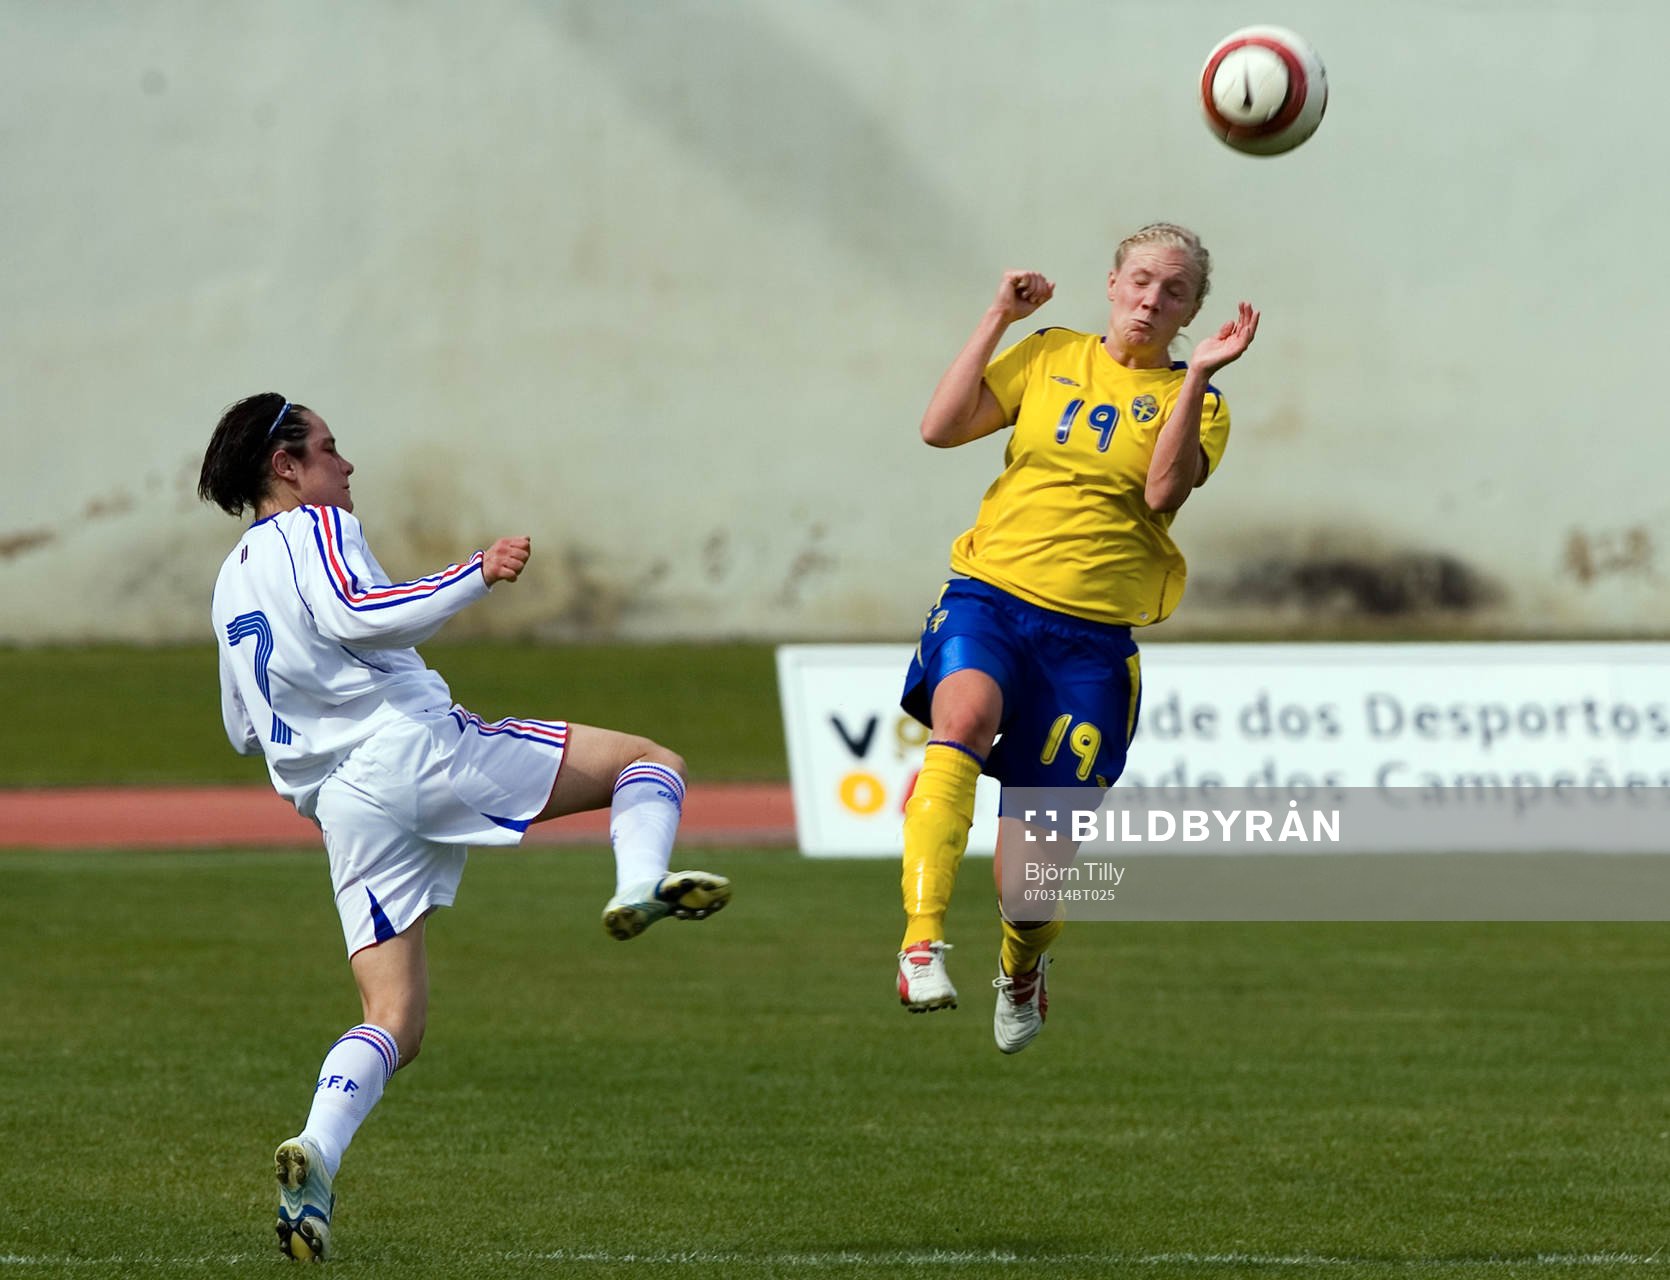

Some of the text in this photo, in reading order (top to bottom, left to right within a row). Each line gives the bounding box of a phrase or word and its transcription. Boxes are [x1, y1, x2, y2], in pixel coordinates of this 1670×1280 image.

[1055, 397, 1120, 453] 19
[226, 610, 293, 746] 7
[1040, 713, 1102, 782] 19
[1237, 686, 1343, 741] dos
[1364, 692, 1670, 752] Desportos
[1245, 757, 1347, 806] dos
